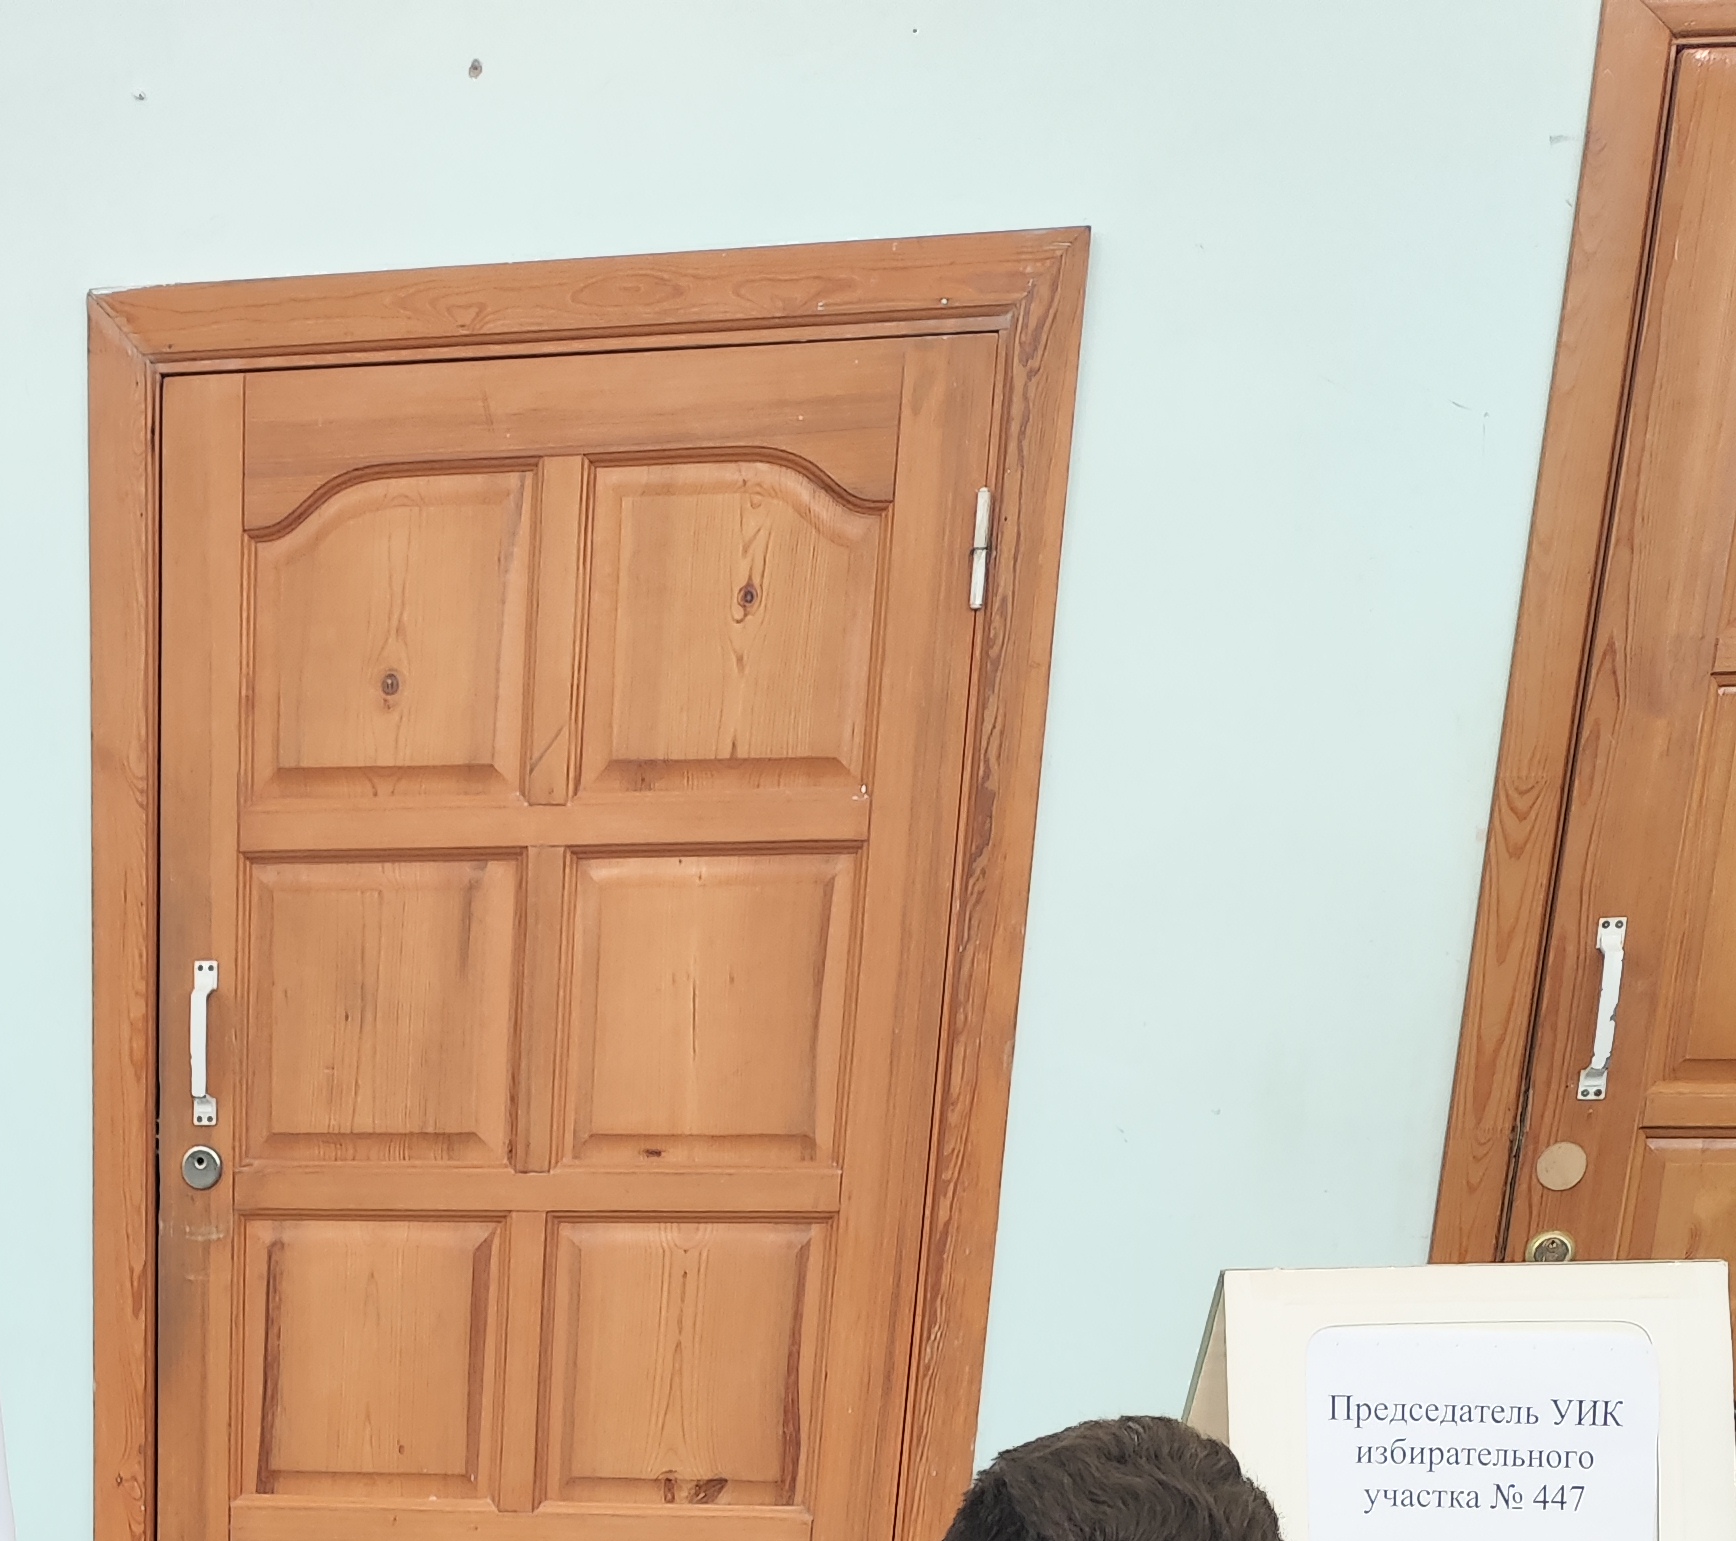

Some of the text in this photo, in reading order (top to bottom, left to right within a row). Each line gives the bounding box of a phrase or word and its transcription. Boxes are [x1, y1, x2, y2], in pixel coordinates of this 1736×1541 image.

[1328, 1394, 1624, 1429] Председатель УИК
[1355, 1438, 1595, 1473] избирательного
[1364, 1483, 1585, 1514] участка № 447
